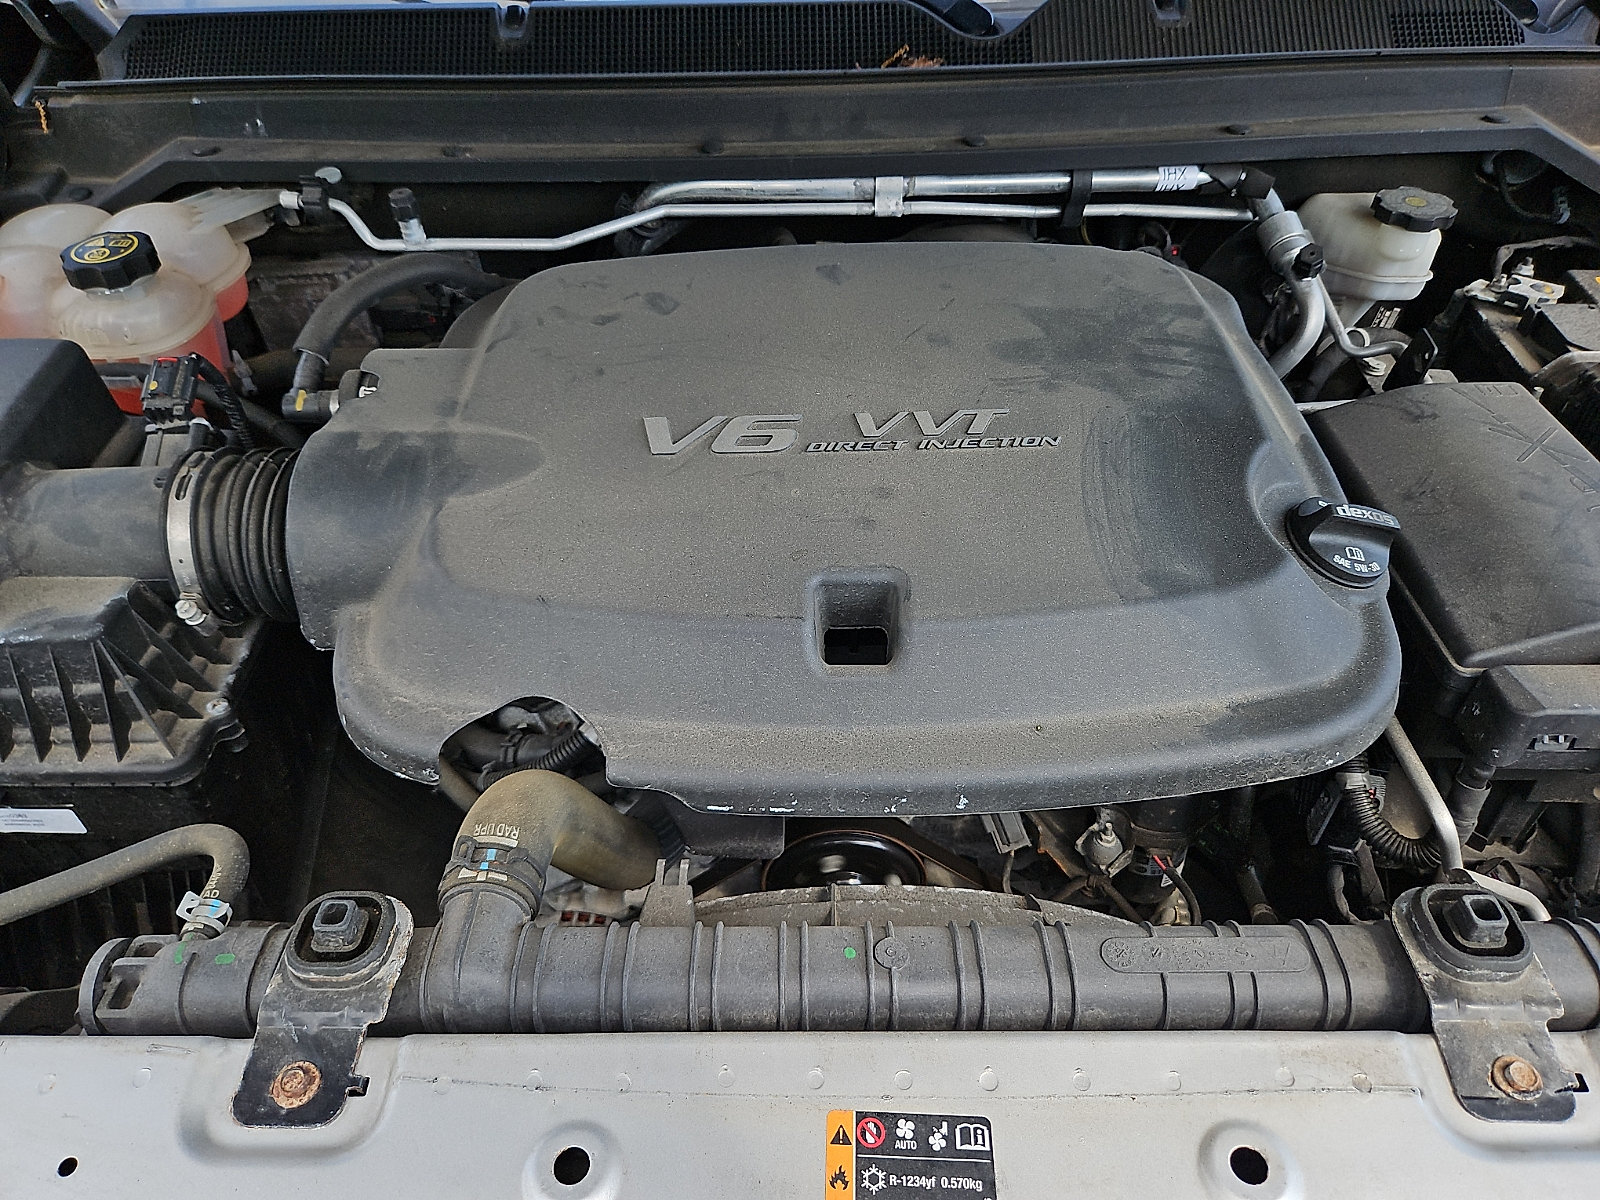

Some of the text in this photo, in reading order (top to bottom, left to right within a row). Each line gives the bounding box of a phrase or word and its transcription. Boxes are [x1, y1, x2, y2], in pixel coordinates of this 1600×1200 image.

[854, 408, 1010, 438] VVT
[643, 414, 803, 455] V6
[805, 436, 1063, 453] DIRECT INJECTION
[1336, 504, 1395, 526] dexos
[1333, 554, 1381, 574] SAE 5W-30
[473, 823, 520, 840] RAD UPR
[894, 1139, 918, 1151] AUTO
[889, 1174, 983, 1192] R-1234yf 0.570kg
